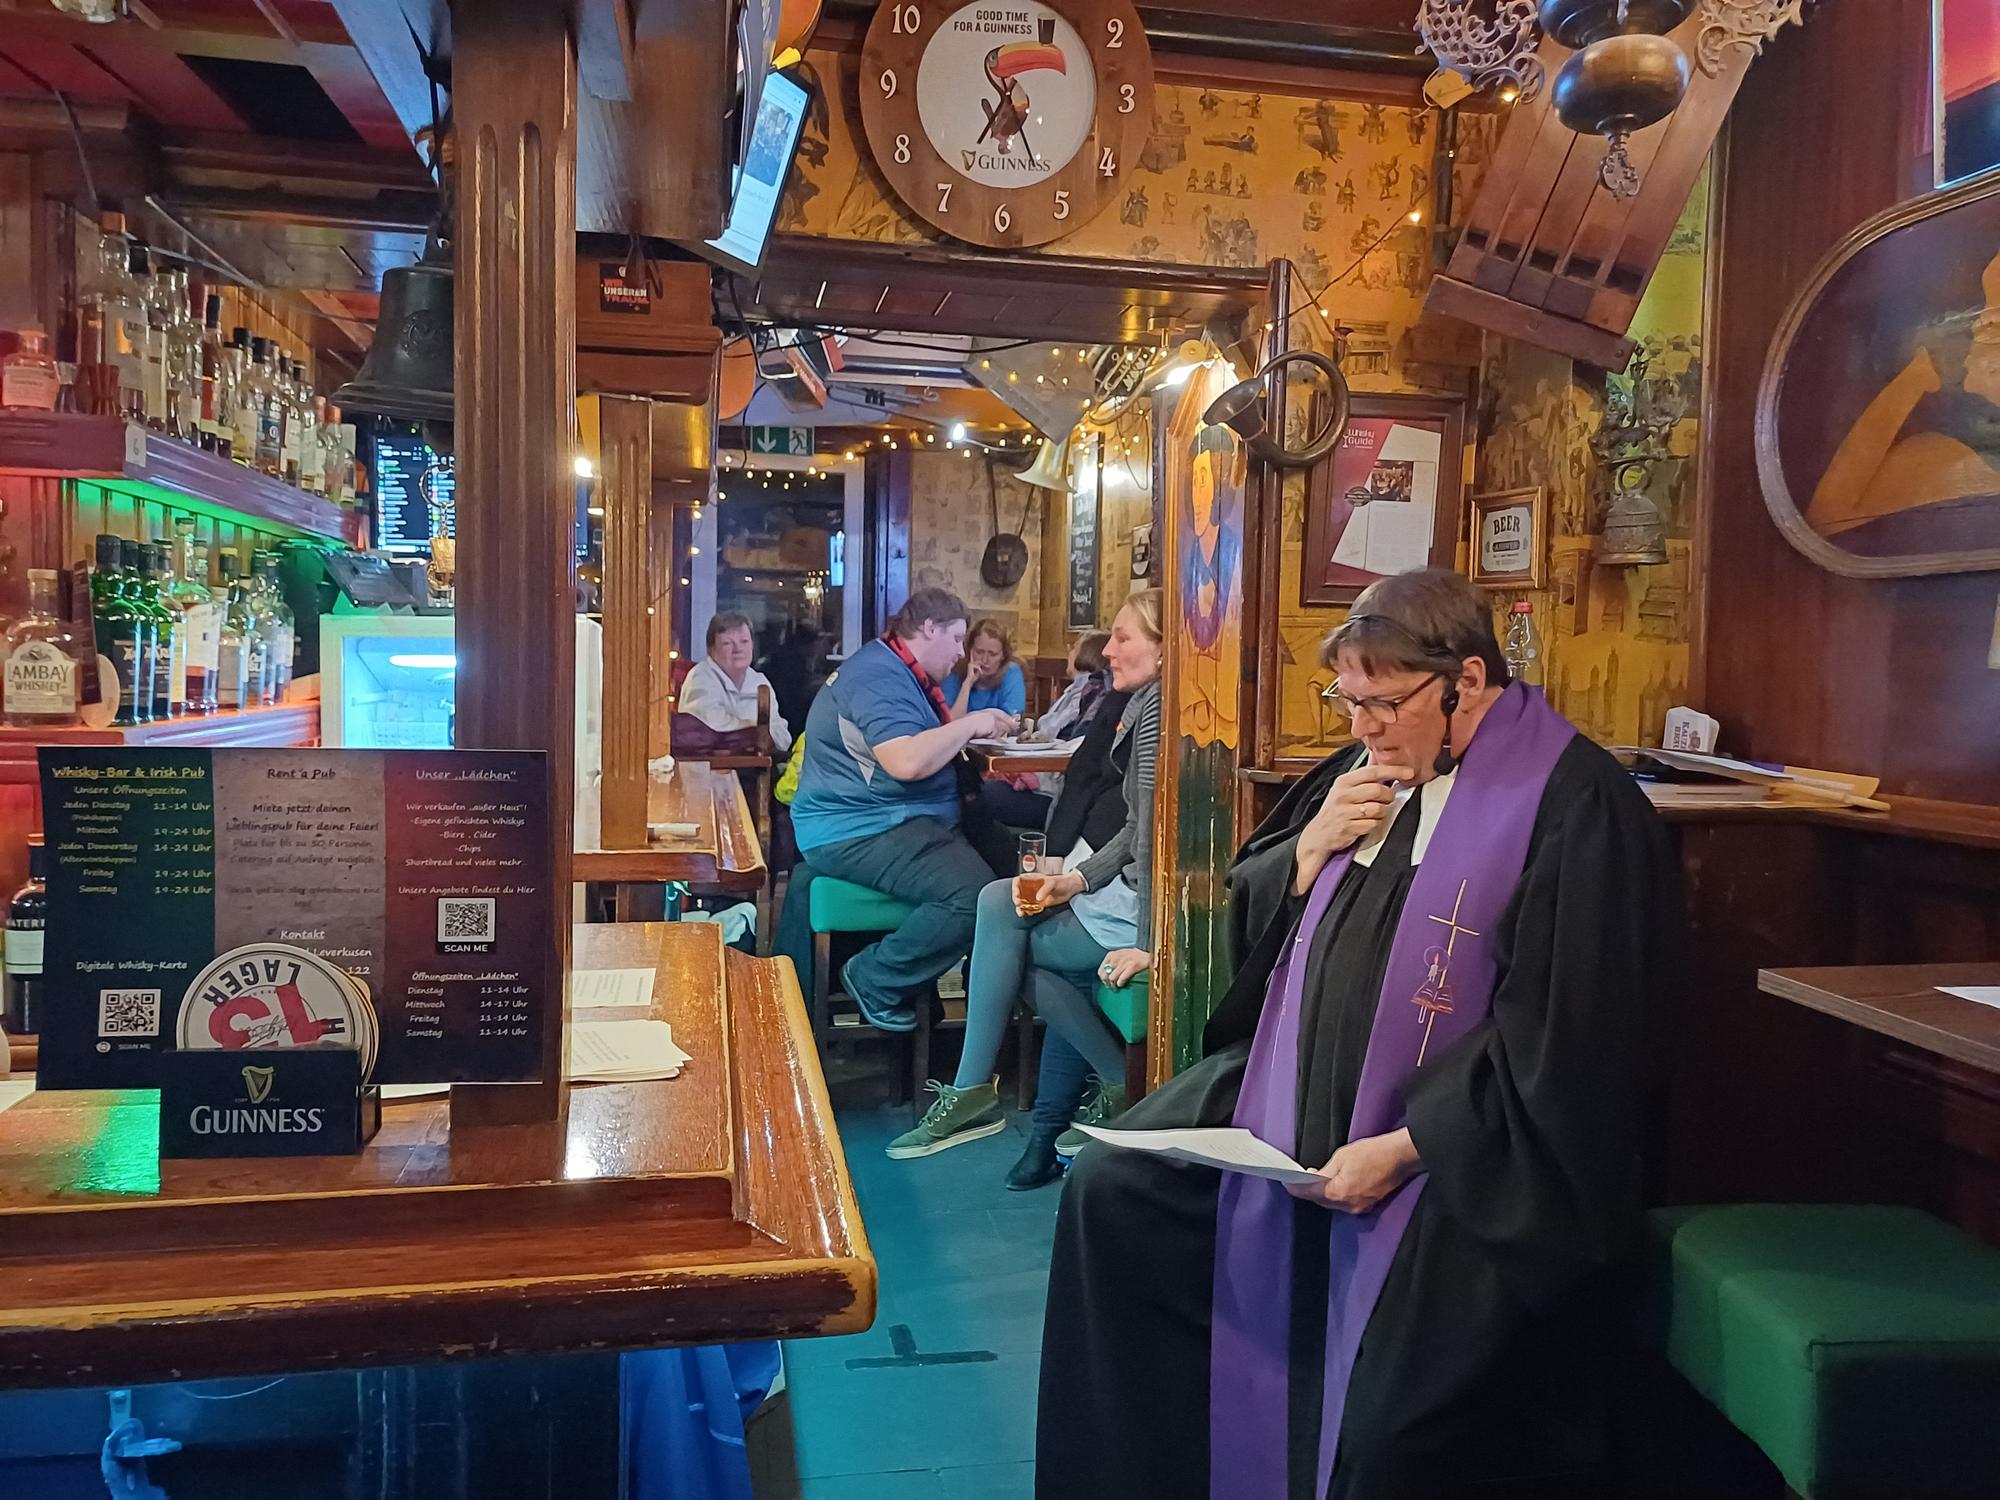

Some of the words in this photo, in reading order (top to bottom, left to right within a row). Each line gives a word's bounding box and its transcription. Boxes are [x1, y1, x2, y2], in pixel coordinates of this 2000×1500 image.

[892, 3, 921, 34] 10
[976, 10, 1003, 21] GOOD
[1005, 11, 1029, 22] TIME
[953, 21, 973, 32] FOR
[975, 22, 982, 32] A
[984, 23, 1032, 35] GUINNESS
[1106, 18, 1124, 49] 2
[880, 69, 897, 99] 9
[1118, 83, 1135, 114] 3
[893, 133, 911, 164] 8
[978, 154, 1051, 173] GUINNESS
[1099, 147, 1116, 177] 4
[936, 182, 953, 212] 7
[1053, 190, 1070, 220] 5
[994, 203, 1011, 233] 6
[1348, 437, 1374, 446] Guide
[1493, 515, 1520, 535] BEER
[52, 766, 130, 779] Whisky-Bar
[134, 767, 145, 778] &
[150, 767, 177, 778] Irish
[182, 767, 205, 778] Pub
[267, 768, 297, 778] Rent
[311, 768, 336, 779] Pub
[416, 770, 451, 779] Unser
[74, 785, 108, 795] Unsere
[113, 784, 187, 797] Öffnungszeiten
[63, 801, 89, 810] Jeden
[92, 801, 130, 811] Dienstag
[153, 803, 187, 811] 11-14
[192, 803, 211, 811] Uhr
[253, 804, 283, 813] Miete
[286, 804, 312, 815] jetzt
[316, 804, 352, 813] deinen
[424, 803, 466, 811] verkaufen
[226, 821, 293, 832] Lieblingspub
[296, 822, 313, 831] für
[316, 822, 345, 831] deine
[492, 817, 525, 827] Whiskys
[153, 828, 188, 836] 19-24
[192, 828, 212, 836] Uhr
[473, 830, 497, 839] Cider
[405, 858, 453, 866] Shortbread
[455, 858, 472, 866] und
[474, 858, 496, 866] vieles
[155, 870, 188, 878] 19-24
[193, 870, 212, 878] Uhr
[193, 886, 213, 894] Uhr
[398, 886, 427, 894] Unsere
[430, 886, 469, 896] Angebote
[471, 886, 500, 894] findest
[503, 886, 514, 894] du
[517, 886, 535, 894] Hier
[280, 929, 325, 939] Kontakt
[314, 947, 372, 957] Leverkusen
[444, 944, 471, 953] SCAN
[473, 944, 488, 952] ME
[76, 961, 114, 972] Digitale
[412, 971, 473, 982] Öffnungszeiten
[202, 959, 302, 1008] LAGER
[407, 986, 444, 996] Dienstag
[480, 986, 509, 994] 11-14
[512, 986, 529, 994] Uhr
[405, 1001, 445, 1009] Mittwoch
[409, 1015, 440, 1024] Freitag
[406, 1029, 443, 1038] Samstag
[190, 1105, 323, 1134] GUINNESS
